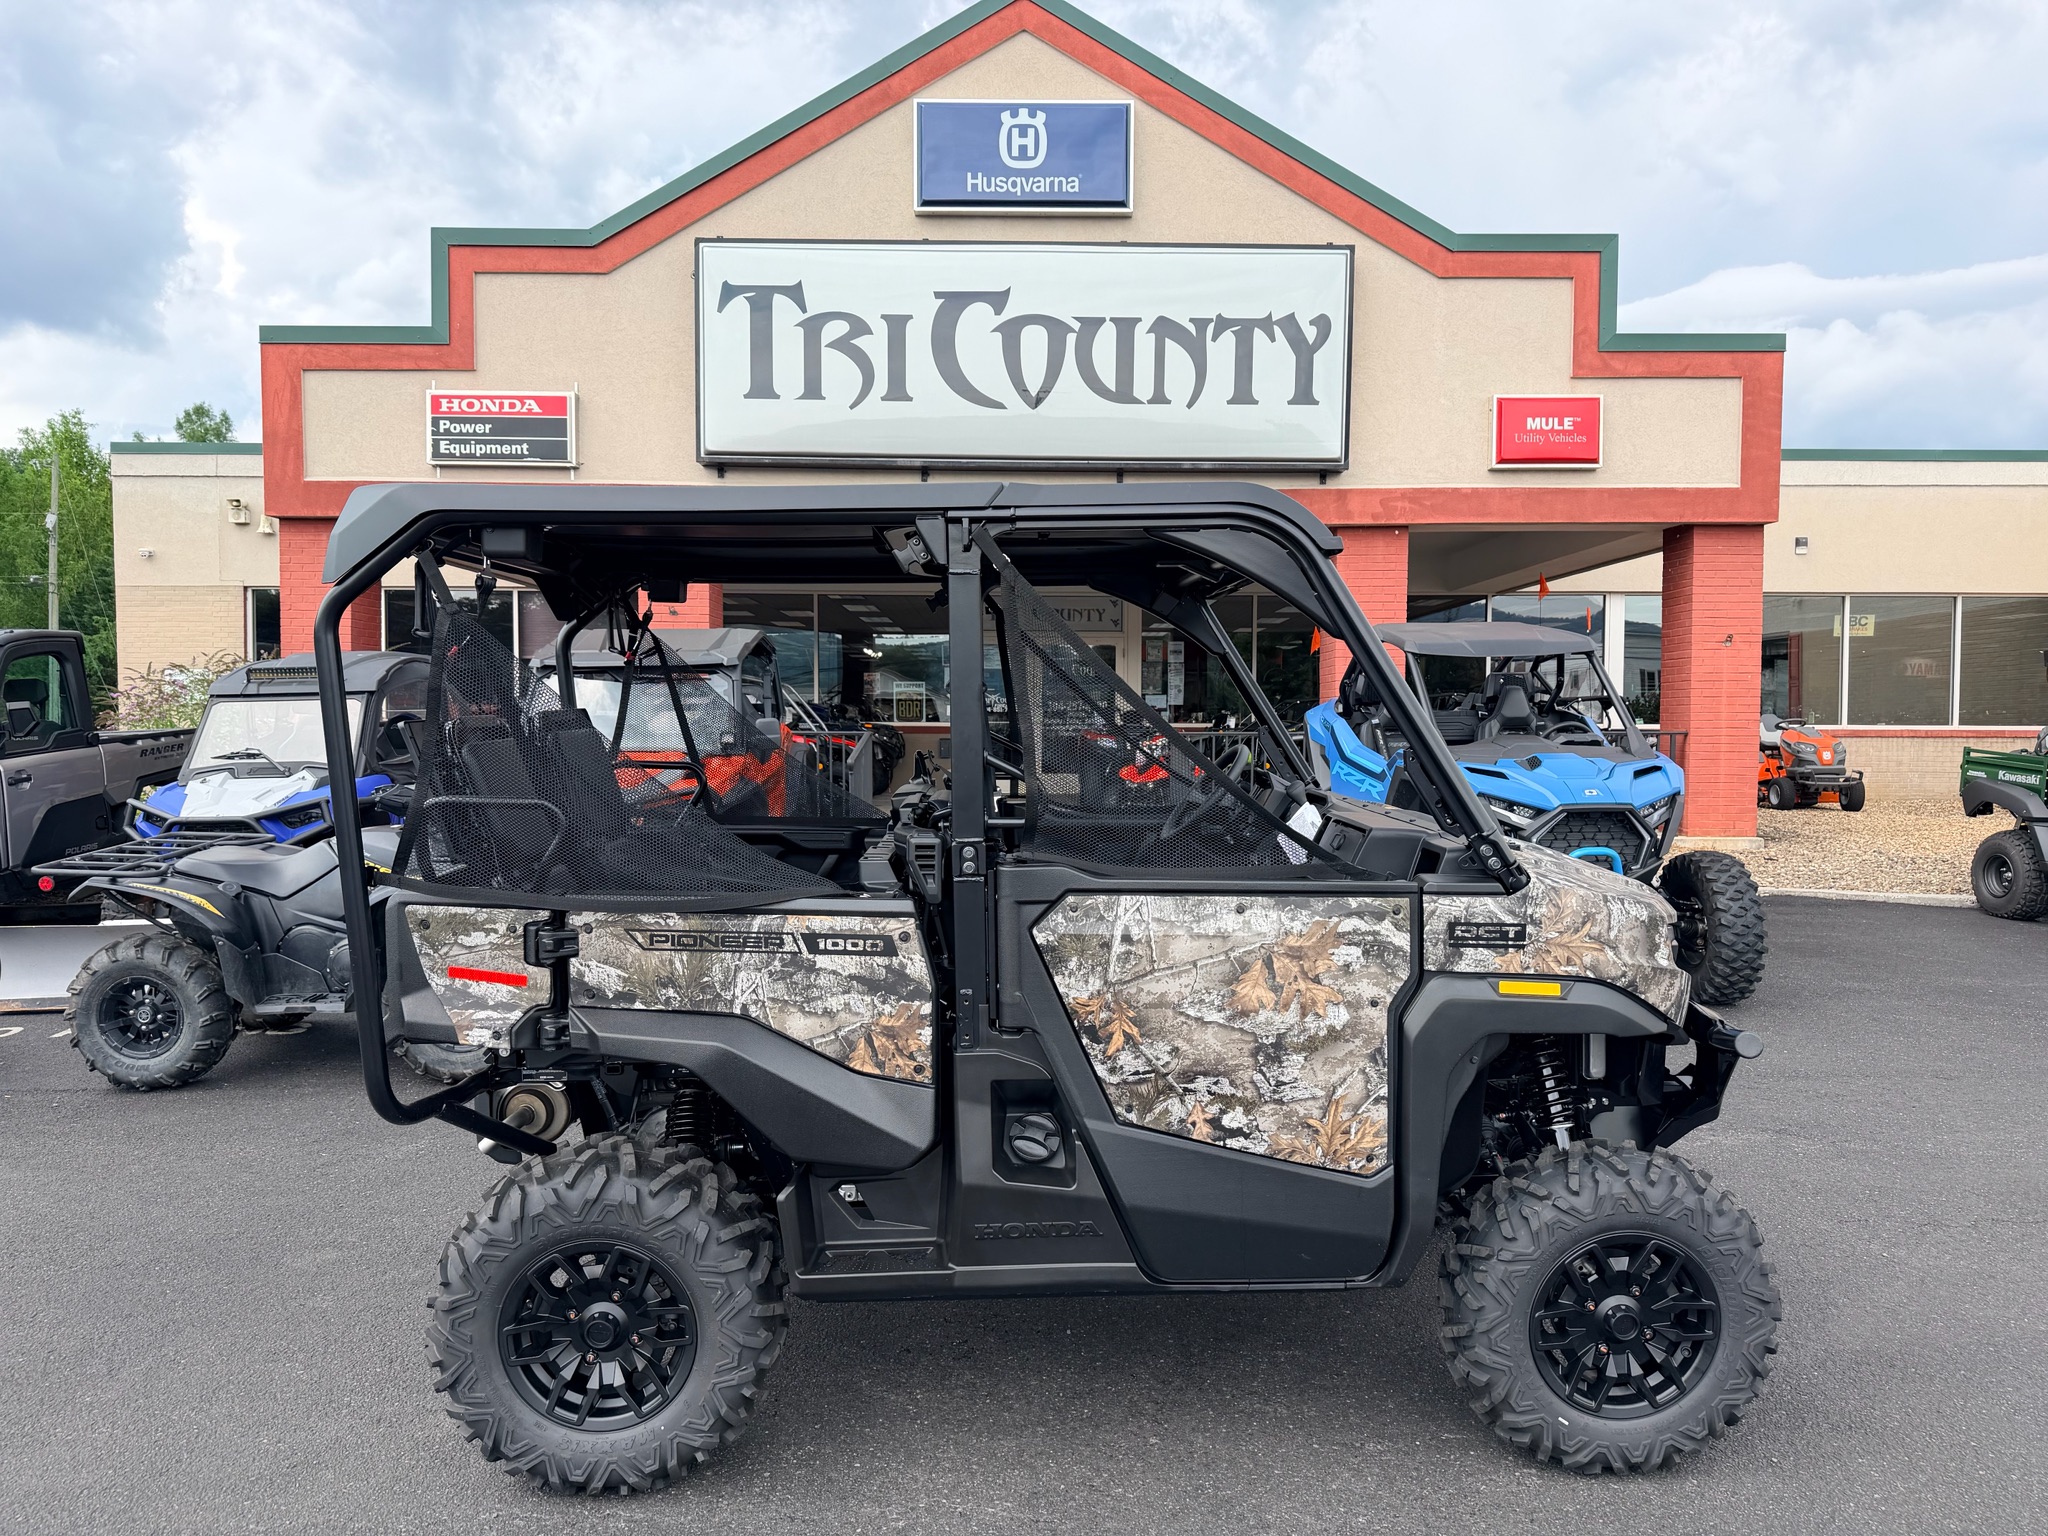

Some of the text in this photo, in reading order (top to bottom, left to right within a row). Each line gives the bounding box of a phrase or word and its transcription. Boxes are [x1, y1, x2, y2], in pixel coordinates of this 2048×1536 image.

[966, 171, 1080, 196] Husqvarna
[930, 285, 1333, 410] COUNTY
[439, 398, 543, 413] HONDA
[439, 420, 492, 434] Power
[1514, 432, 1587, 445] Utility Vehicles
[439, 440, 530, 457] Equipment
[1054, 608, 1106, 623] UNTY
[1840, 616, 1869, 627] BC
[898, 700, 921, 717] BDR
[139, 743, 185, 758] RANGER
[1331, 759, 1385, 801] RZR
[1998, 769, 2041, 785] Kawasaki
[65, 842, 99, 856] POLARIS
[1453, 925, 1522, 938] DCT
[649, 933, 885, 952] PIONEER 1000
[974, 1220, 1104, 1241] HONDA
